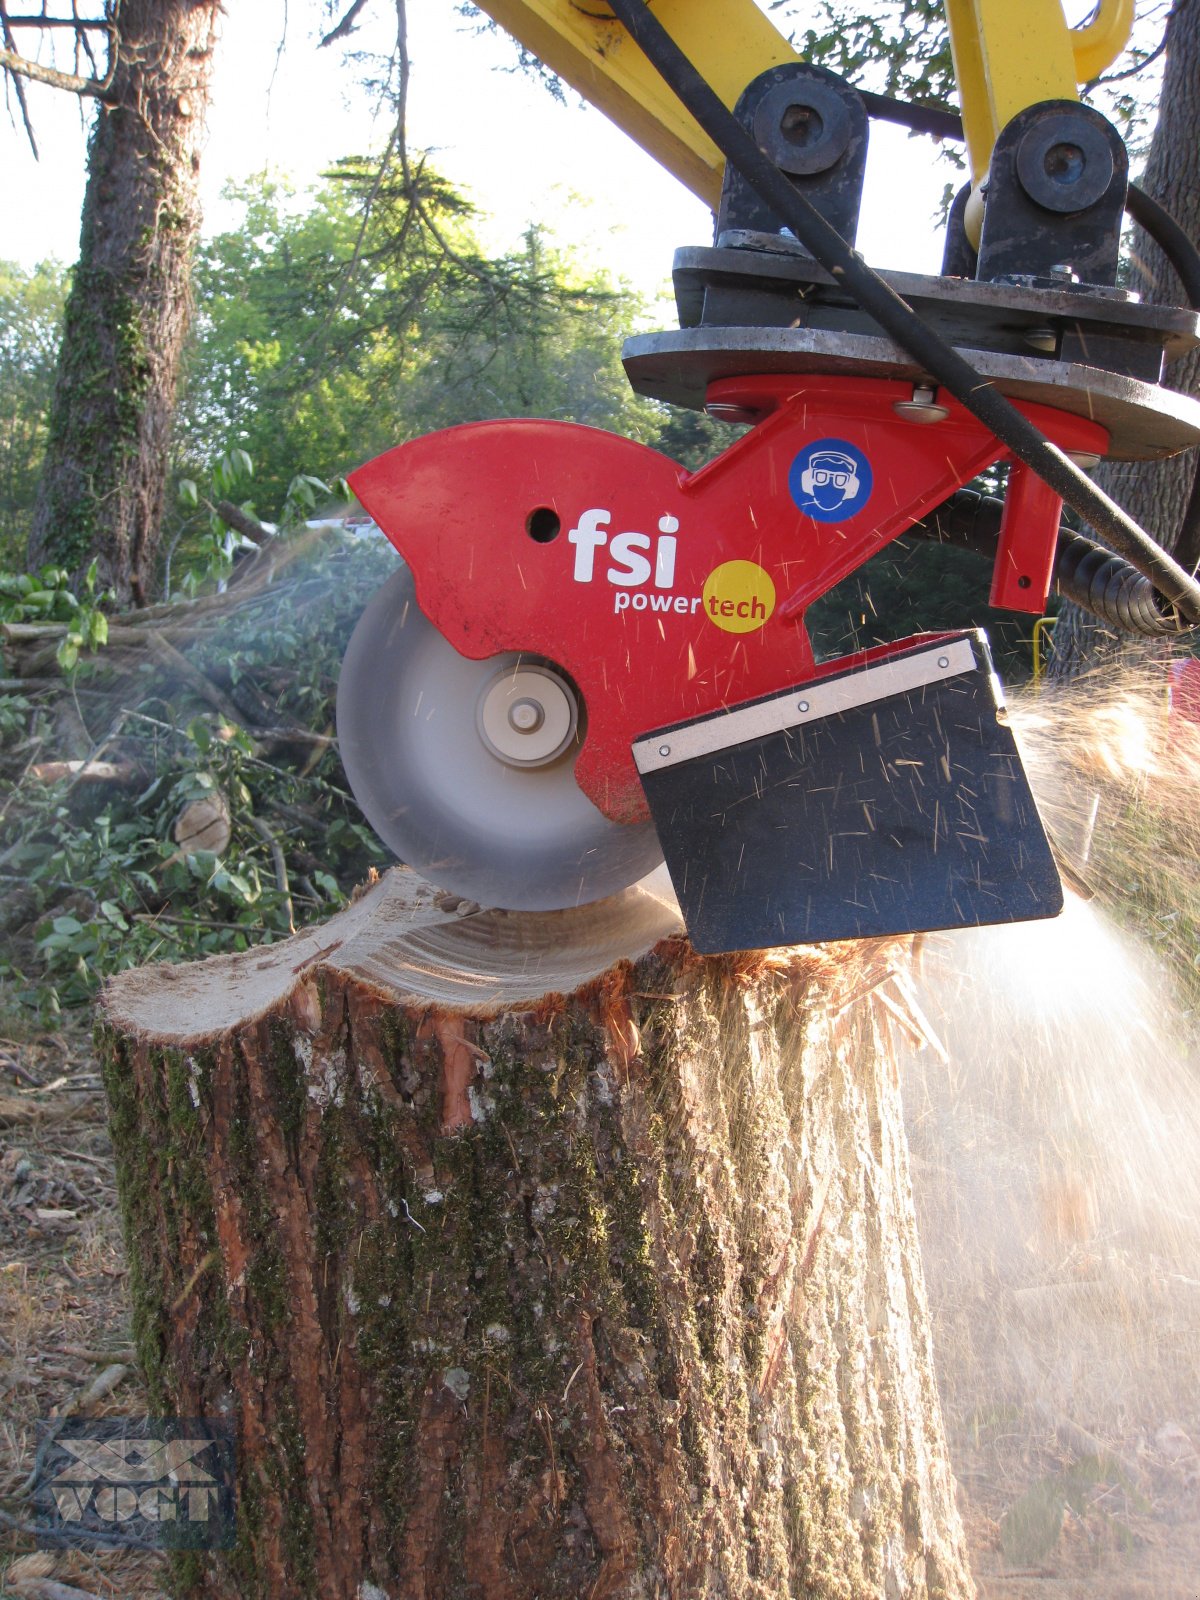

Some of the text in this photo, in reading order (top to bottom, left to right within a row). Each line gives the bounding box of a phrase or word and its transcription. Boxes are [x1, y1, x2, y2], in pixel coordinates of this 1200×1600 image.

[568, 508, 680, 589] fsi
[614, 592, 766, 619] power tech
